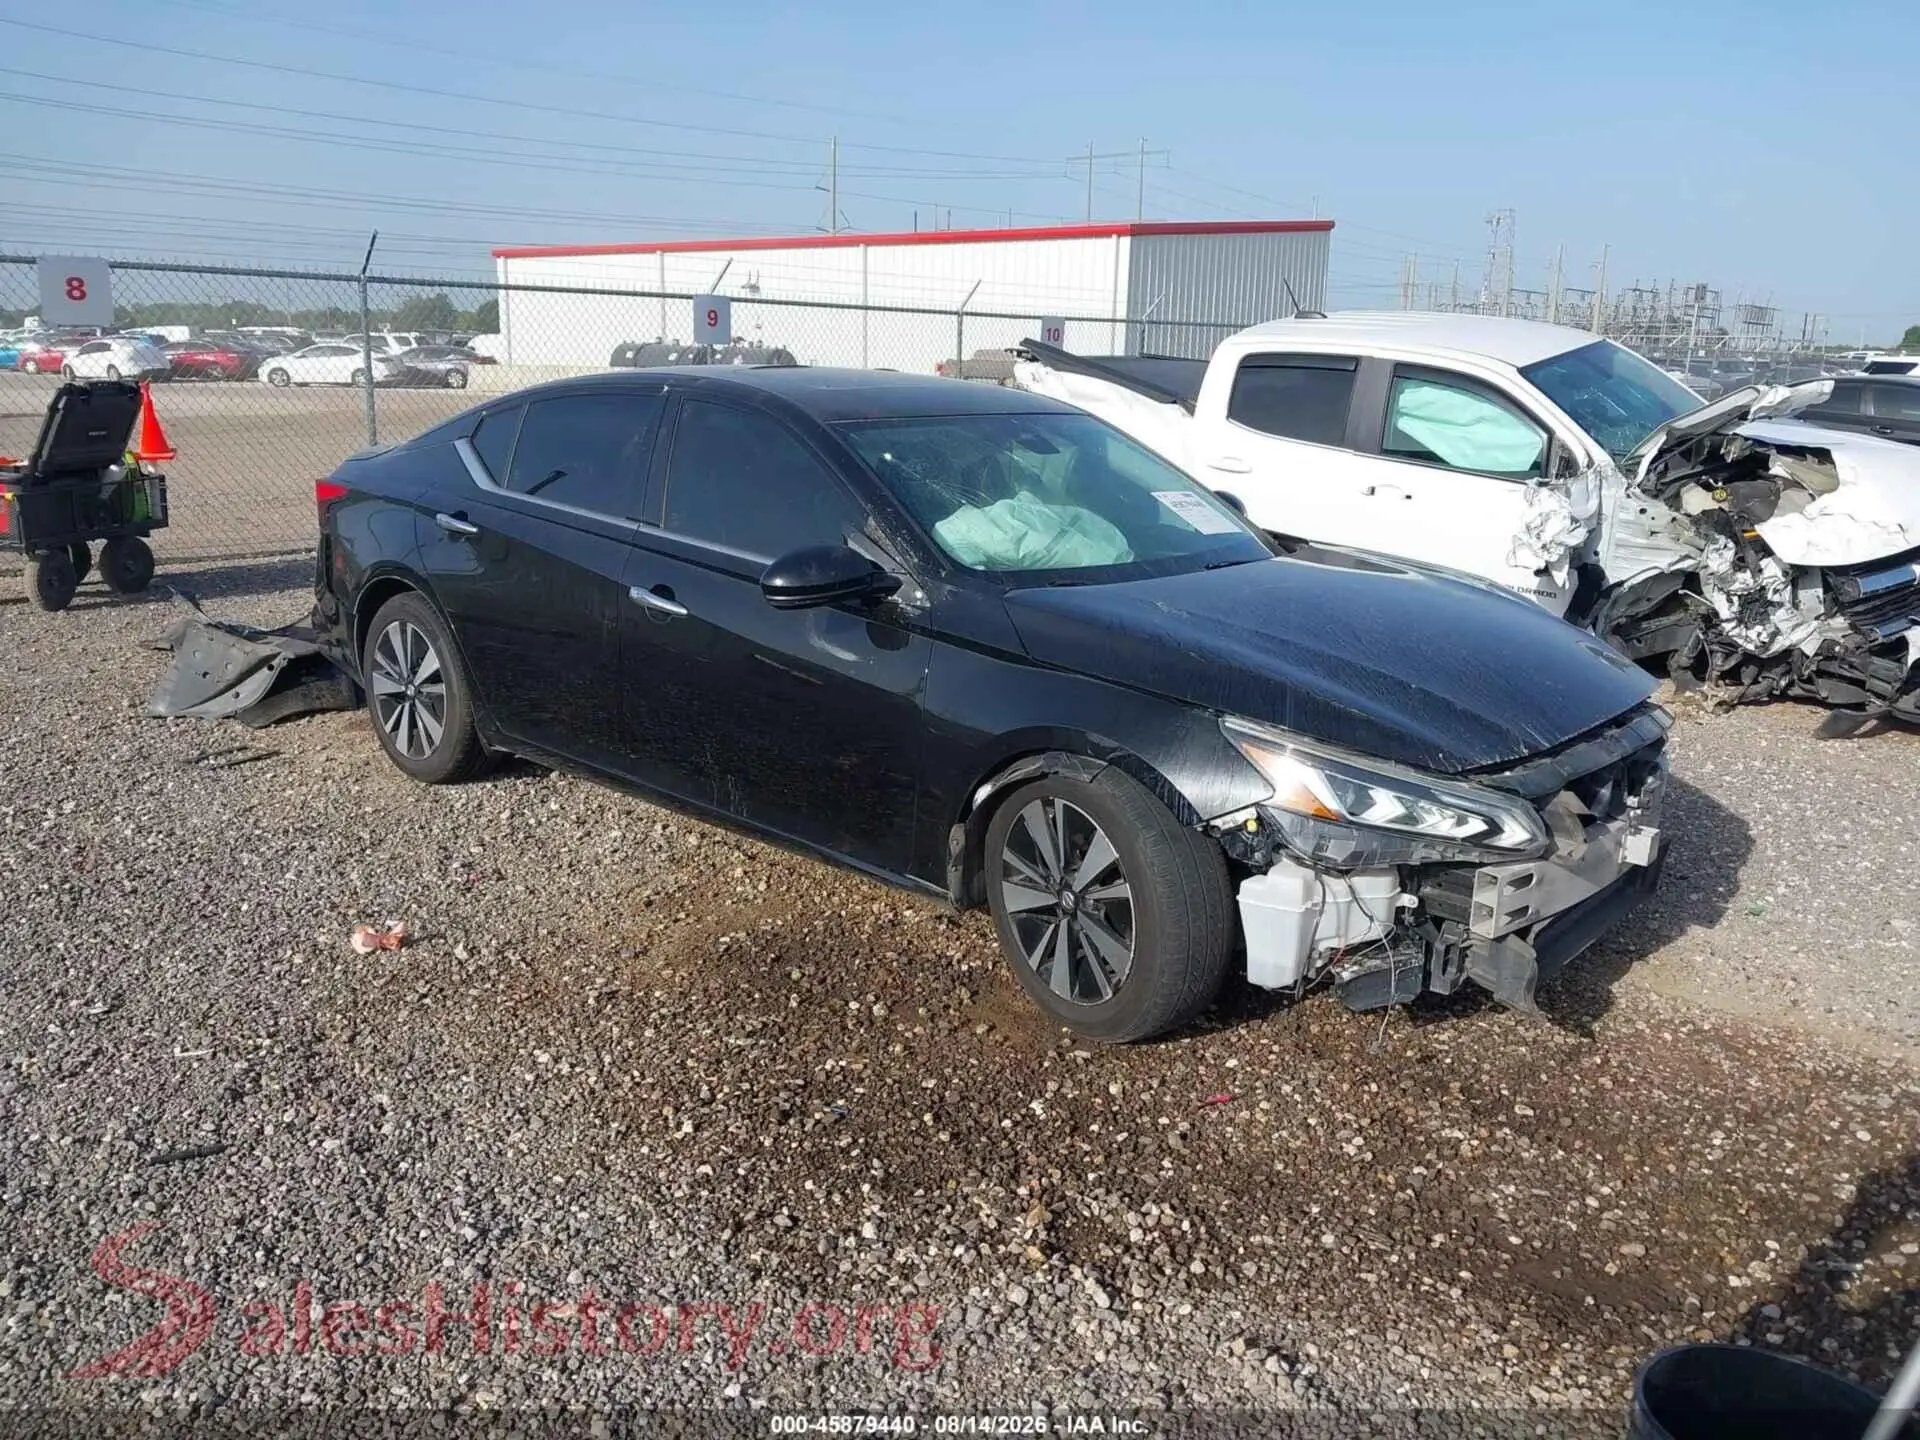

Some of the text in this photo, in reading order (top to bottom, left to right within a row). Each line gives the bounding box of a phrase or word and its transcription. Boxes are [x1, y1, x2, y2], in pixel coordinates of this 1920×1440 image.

[65, 276, 87, 301] 8
[707, 309, 719, 328] 9
[1046, 327, 1060, 342] 10
[1503, 584, 1558, 599] ORADO
